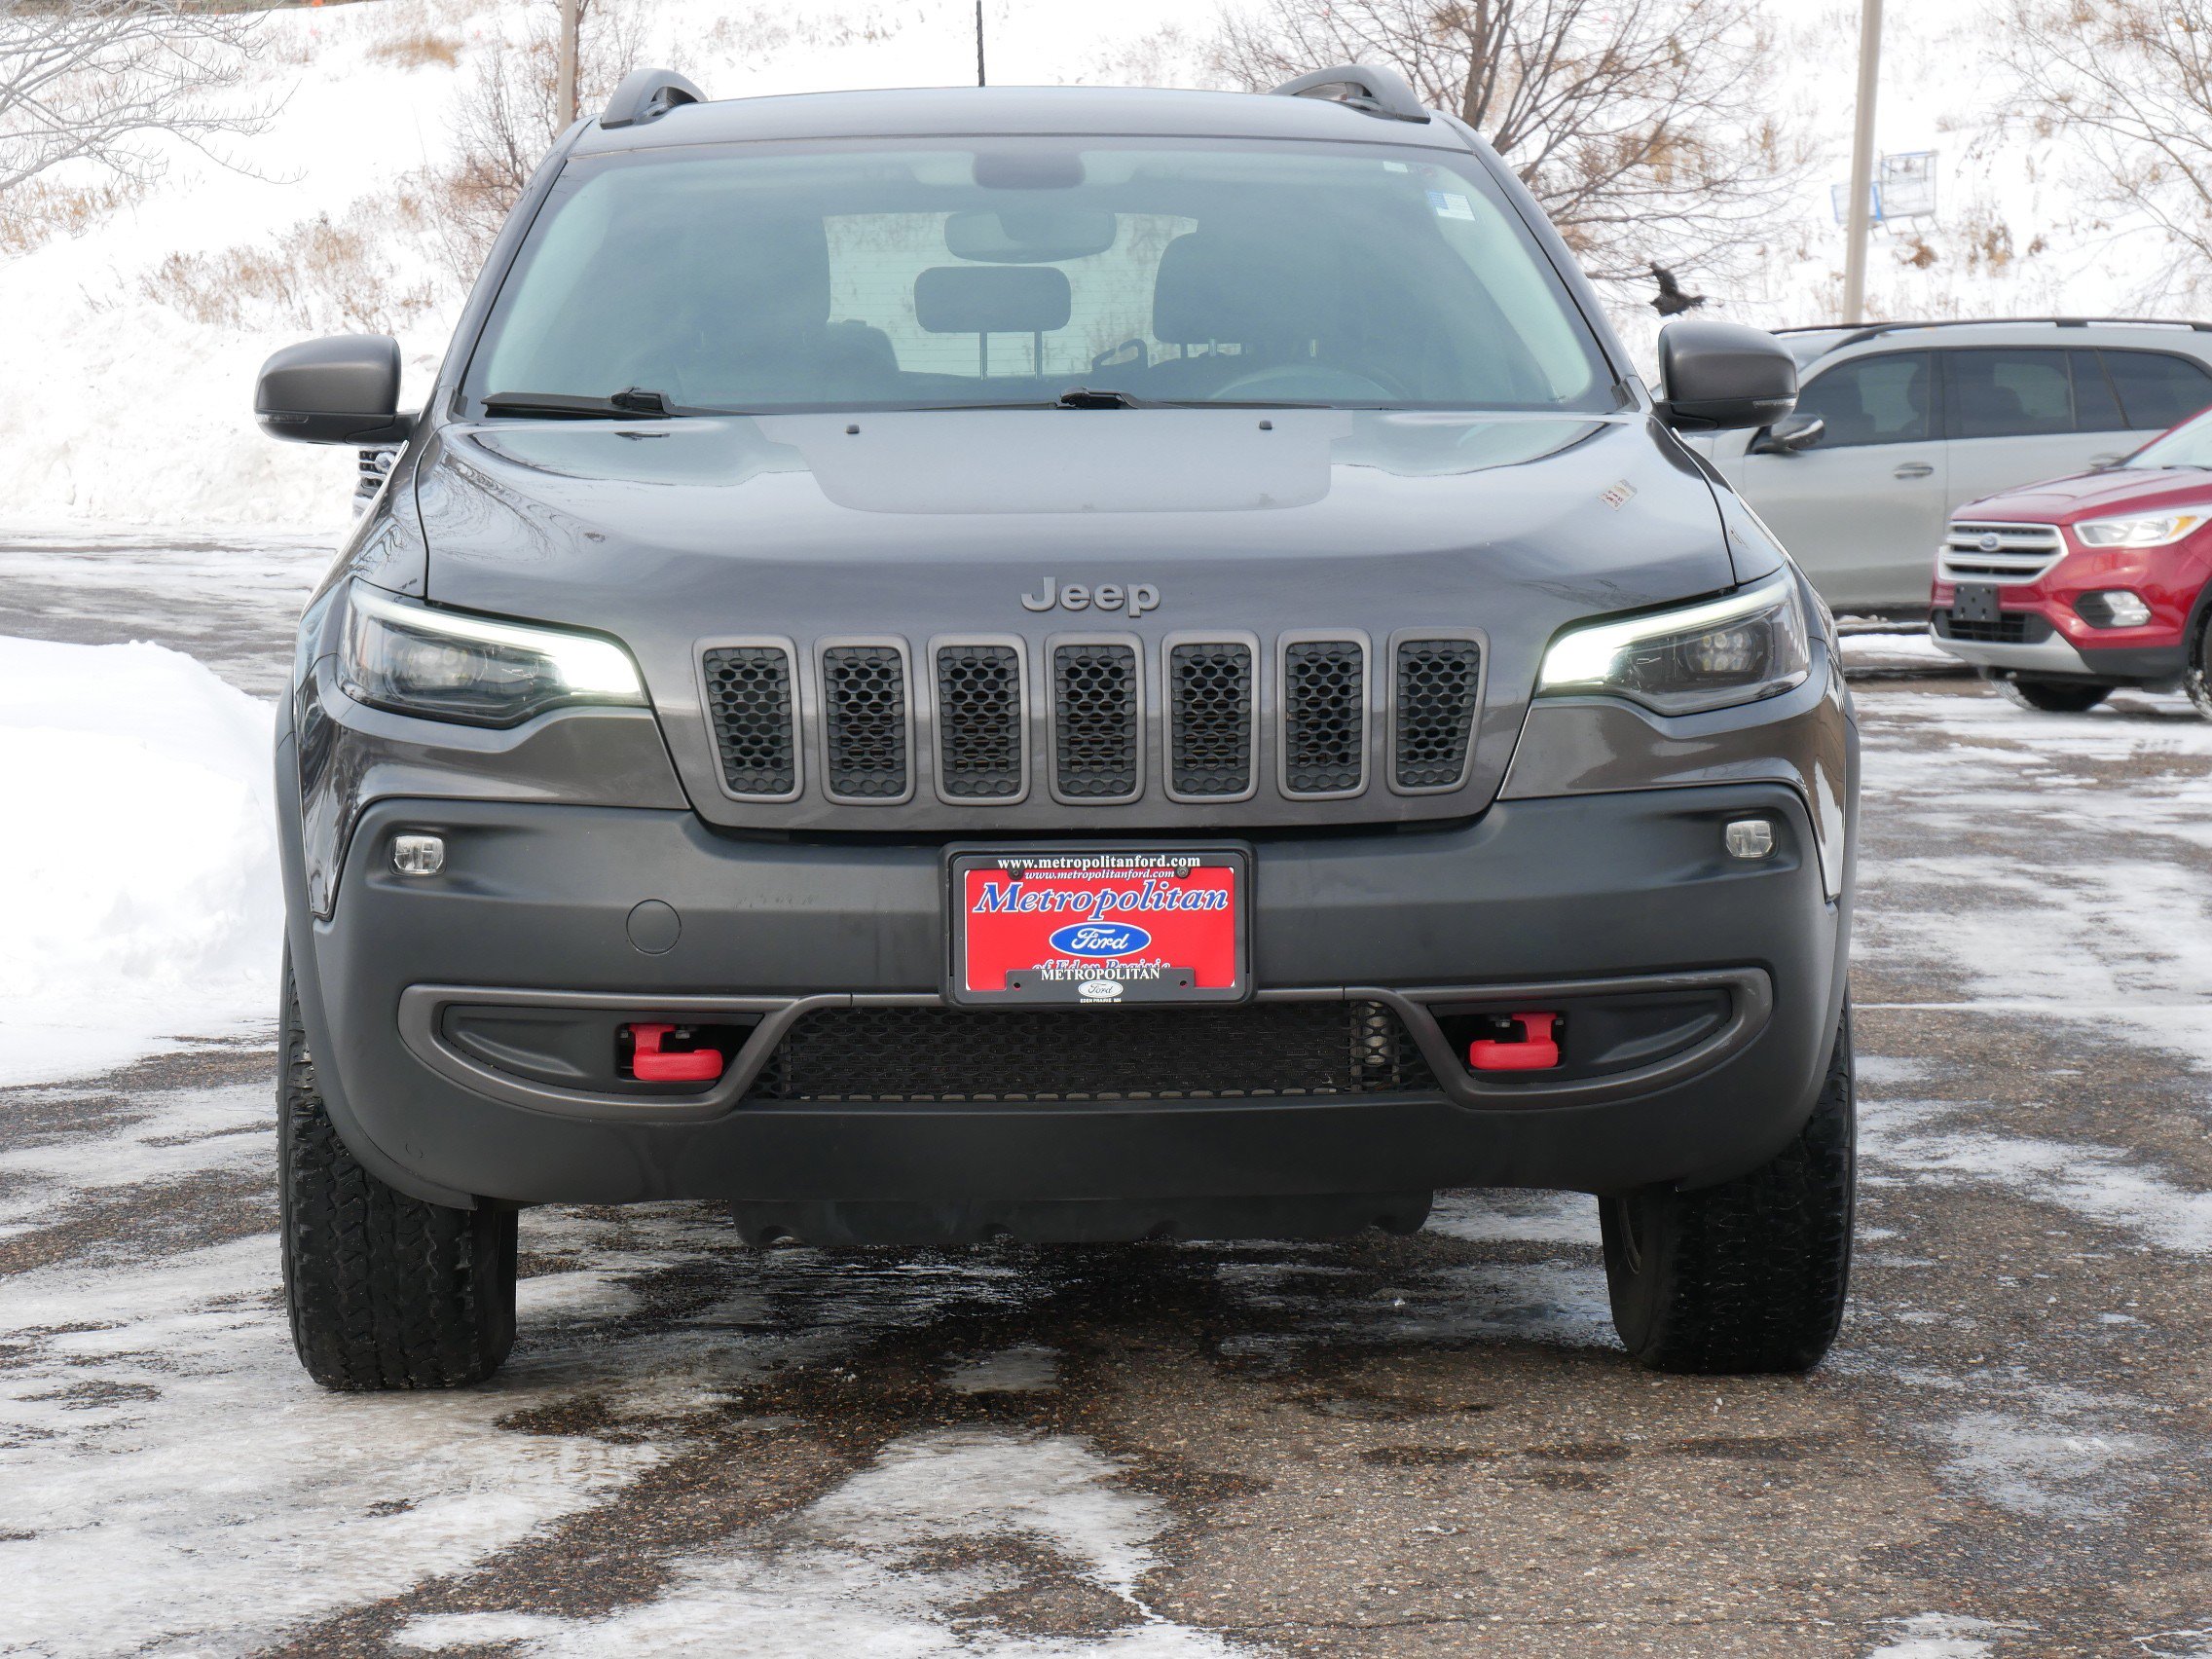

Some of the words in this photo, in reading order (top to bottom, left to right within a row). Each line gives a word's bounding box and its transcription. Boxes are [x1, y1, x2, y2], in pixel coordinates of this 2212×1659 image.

[1021, 576, 1161, 617] Jeep
[997, 855, 1200, 870] www.metropolitanford.com
[1025, 868, 1175, 881] www.metropolitanford.com
[972, 878, 1229, 921] Metropolitan
[1071, 927, 1128, 949] Ford
[1041, 968, 1160, 980] METROPOLITAN
[1088, 982, 1114, 994] Ford
